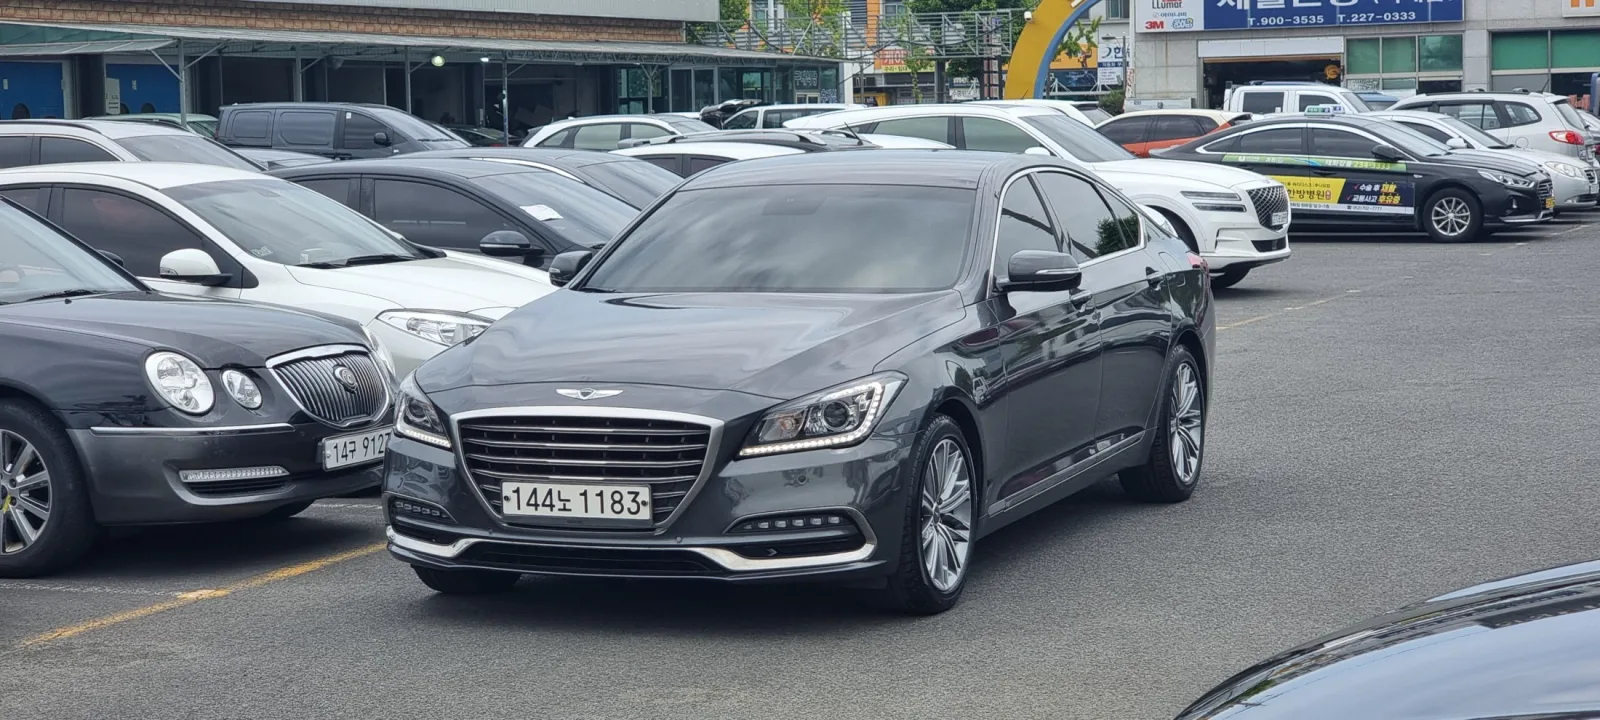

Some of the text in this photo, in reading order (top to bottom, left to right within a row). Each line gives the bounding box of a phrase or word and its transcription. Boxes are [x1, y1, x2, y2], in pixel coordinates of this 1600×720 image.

[1248, 15, 1324, 26] T.900-3535
[1338, 11, 1416, 22] T.227-0333
[1145, 21, 1164, 29] 3M
[1352, 194, 1377, 203] 교통사고
[333, 441, 356, 463] 14구
[512, 486, 641, 515] 144노 1183
